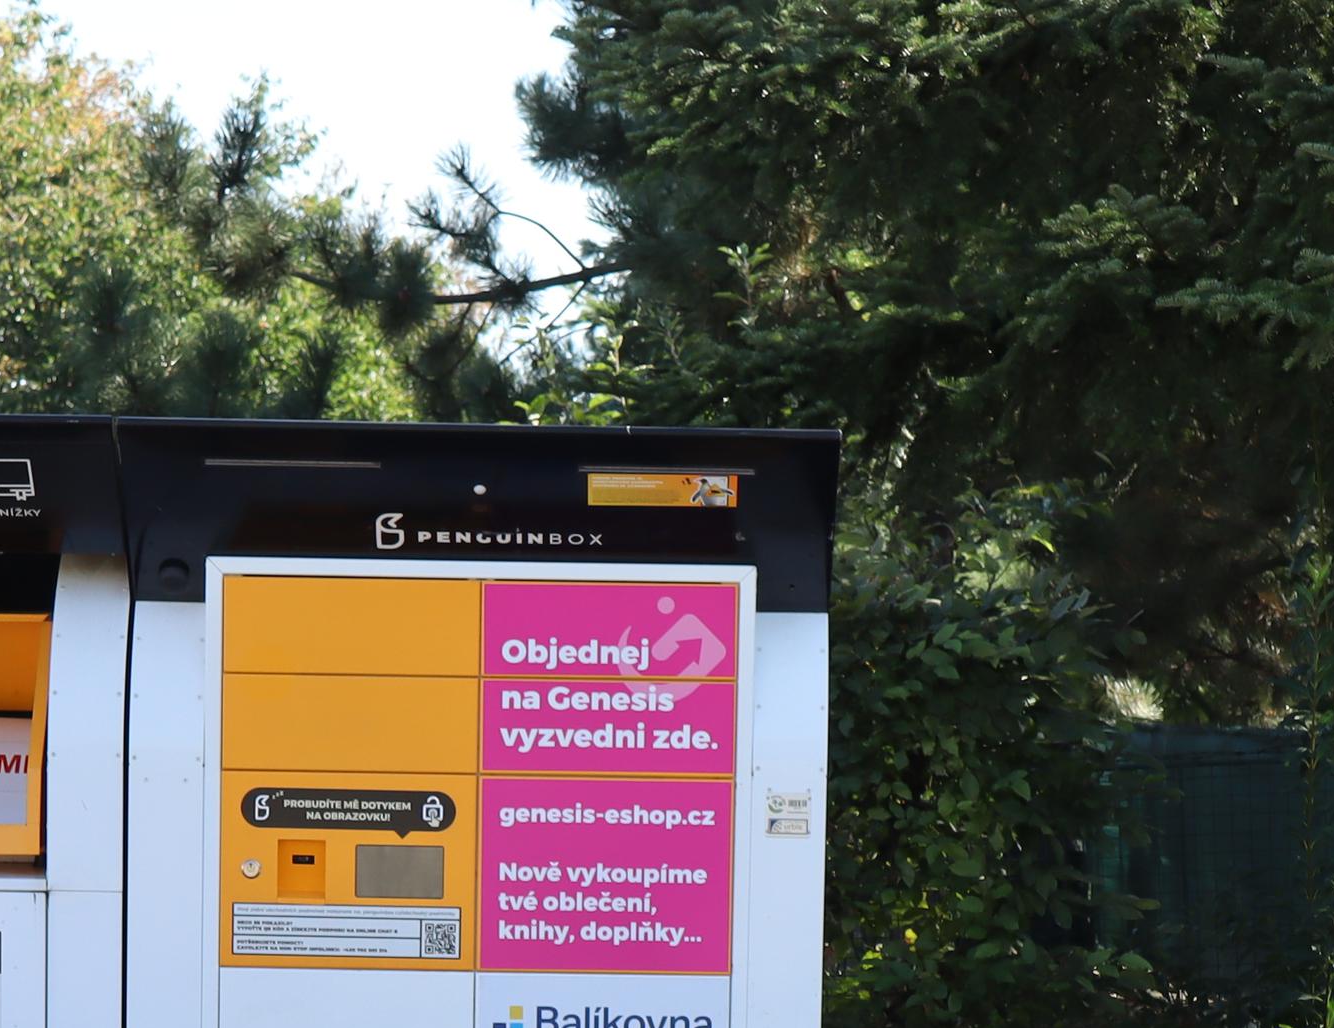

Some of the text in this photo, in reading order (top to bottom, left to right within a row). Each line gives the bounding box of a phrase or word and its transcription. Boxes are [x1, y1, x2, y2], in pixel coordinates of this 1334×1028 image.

[501, 637, 650, 671] Objednej
[501, 685, 675, 712] na Genesis
[499, 721, 719, 753] vyzvedni zde.
[283, 798, 411, 811] PROBUDÍTE MĚ DOTYKEM
[306, 811, 391, 822] NA OBRAZOVKU!
[499, 802, 716, 830] genesis-eshop.cz
[498, 861, 708, 888] Nově vykoupíme
[498, 890, 657, 916] tvé oblečení,
[498, 919, 702, 946] knihy, doplňky...
